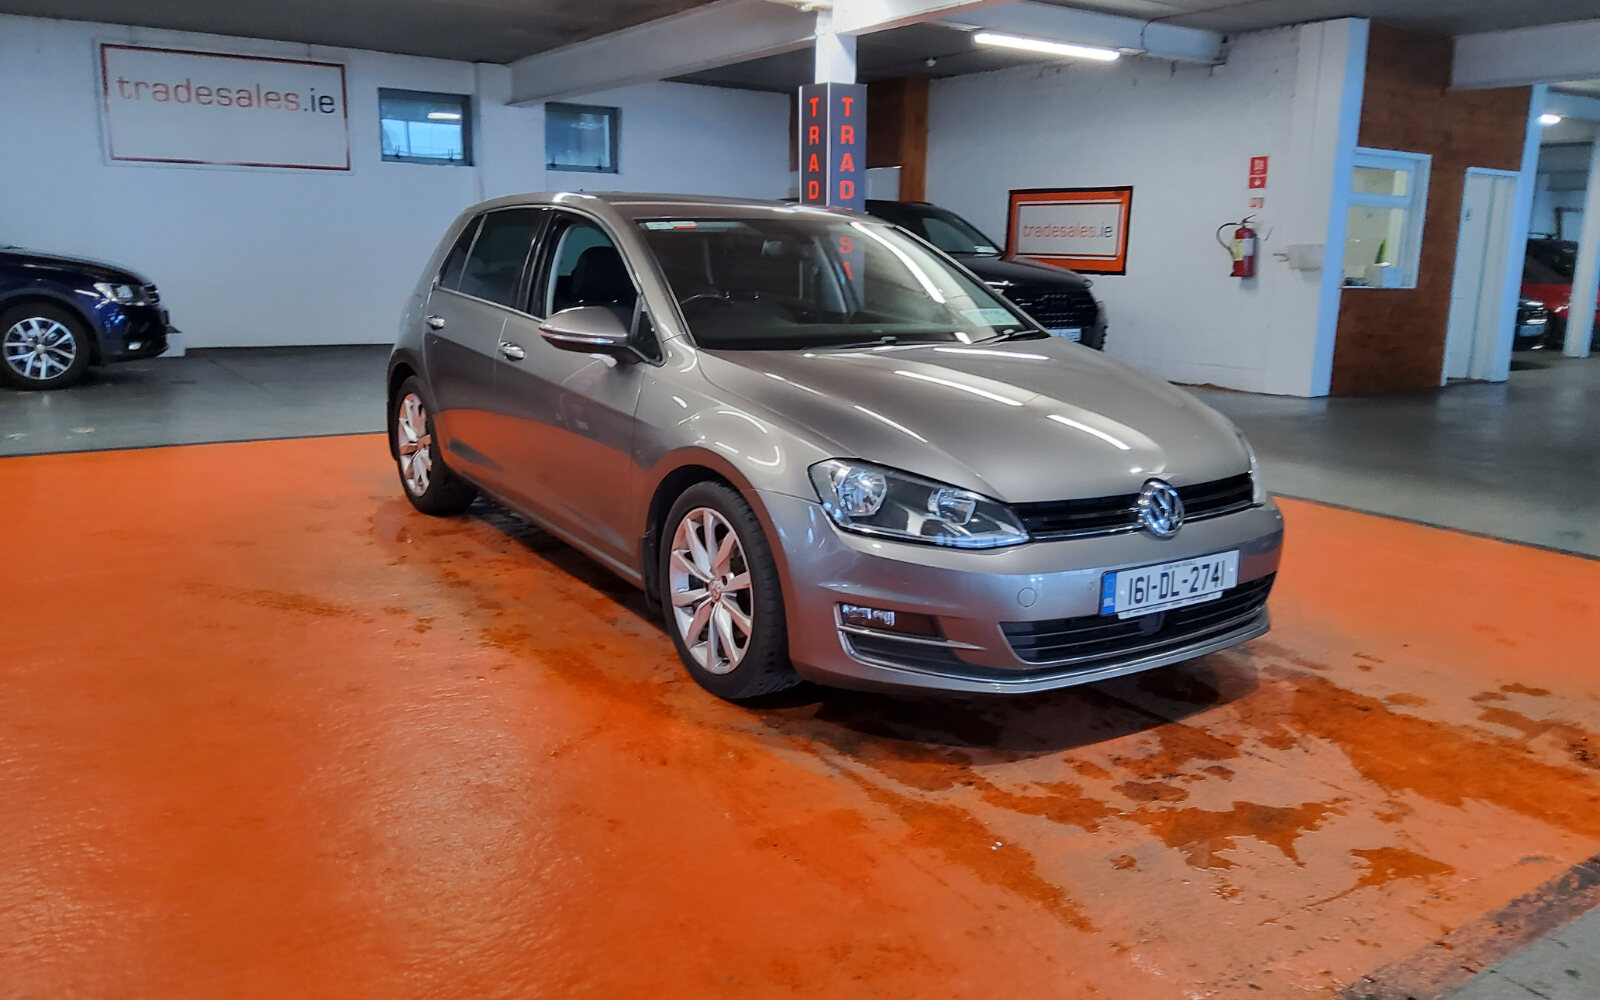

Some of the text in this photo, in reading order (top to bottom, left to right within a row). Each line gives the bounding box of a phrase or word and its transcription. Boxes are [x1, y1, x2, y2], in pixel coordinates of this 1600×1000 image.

[116, 76, 336, 114] tradesales.ie
[1023, 221, 1113, 238] tradesales.ie
[1128, 560, 1226, 606] 161-DL-2741
